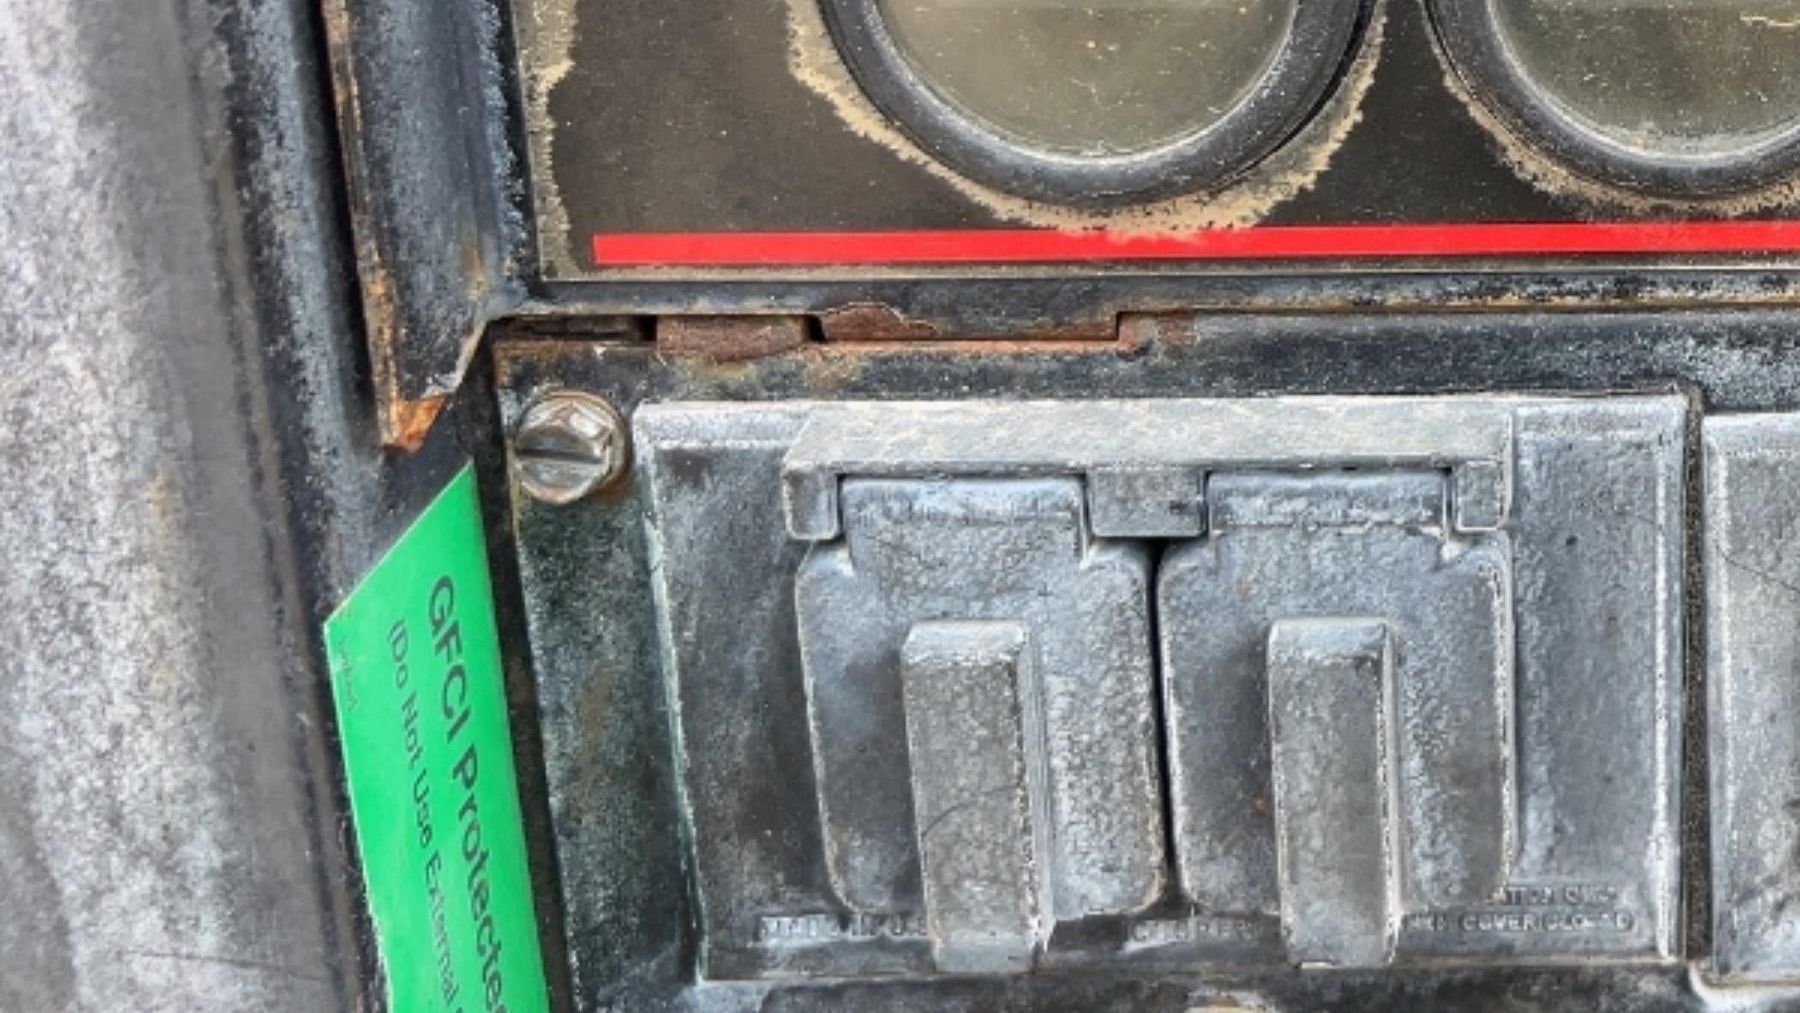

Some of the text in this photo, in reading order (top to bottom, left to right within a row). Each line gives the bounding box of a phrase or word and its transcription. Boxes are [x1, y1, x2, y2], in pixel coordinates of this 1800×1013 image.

[427, 574, 473, 745] GFCI
[401, 691, 425, 767] Not
[413, 769, 434, 850] Use
